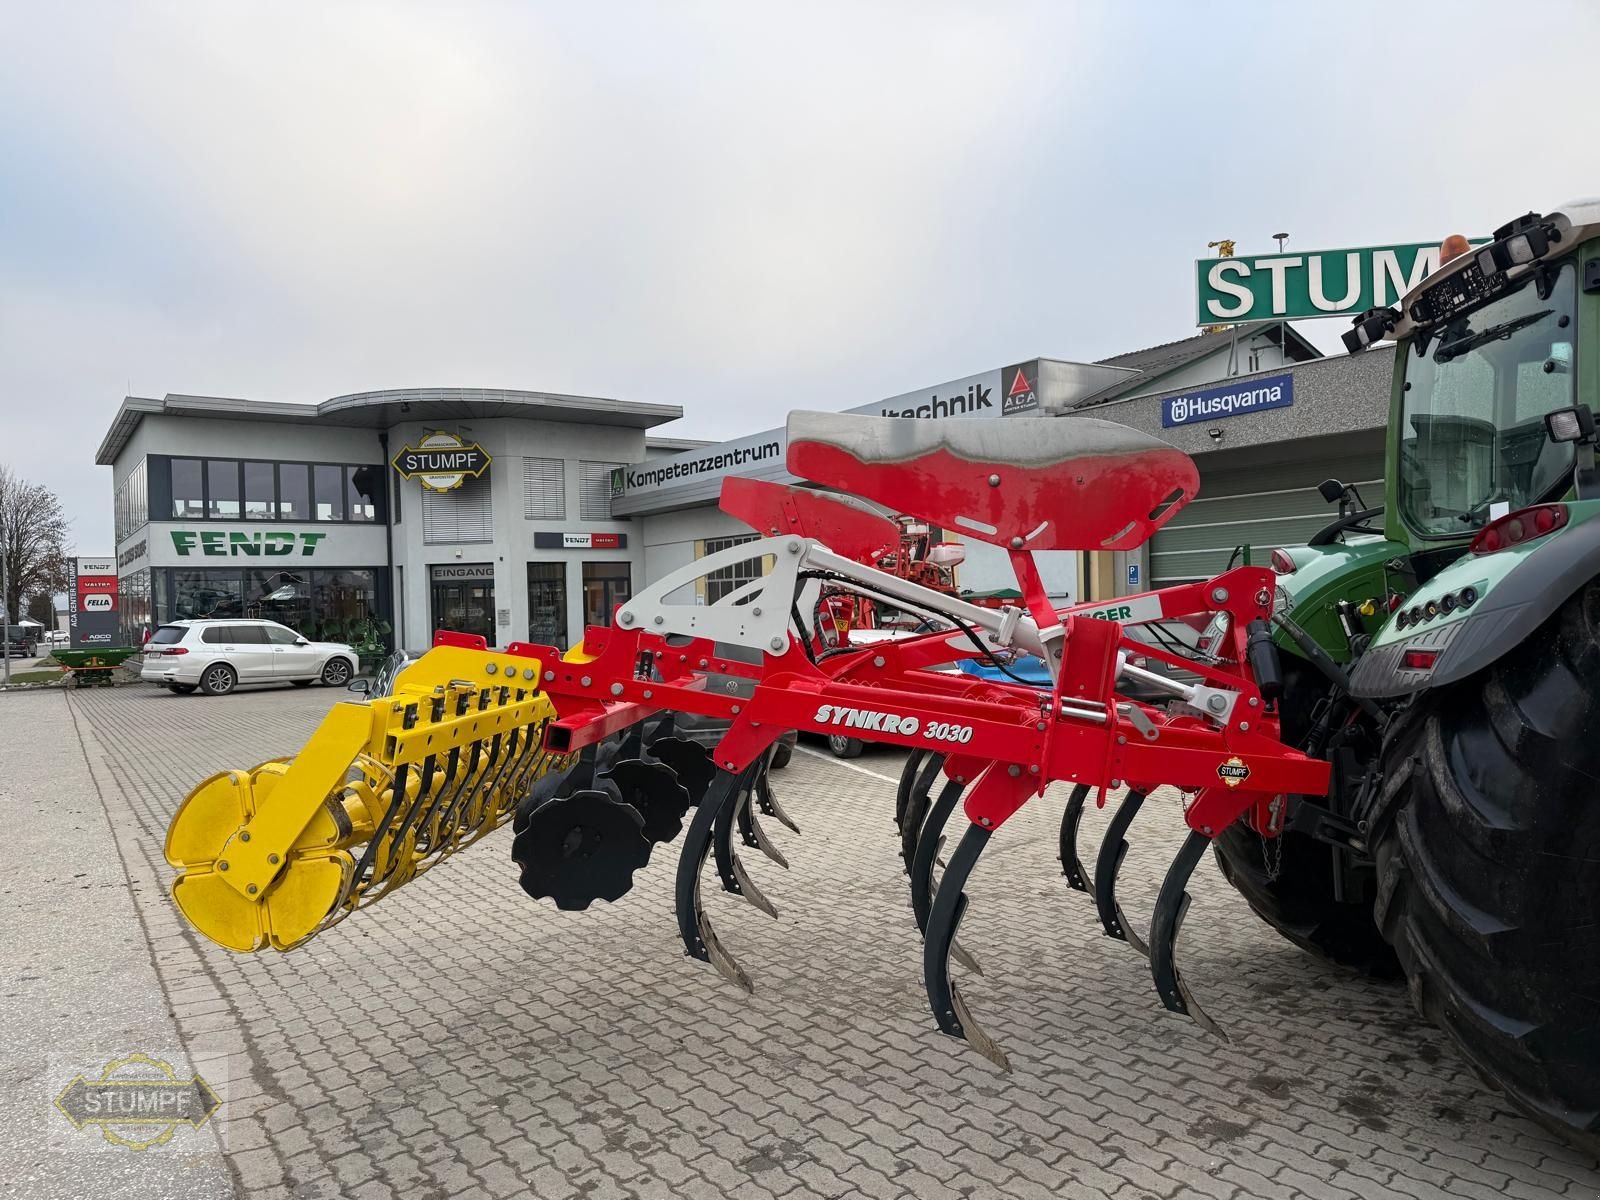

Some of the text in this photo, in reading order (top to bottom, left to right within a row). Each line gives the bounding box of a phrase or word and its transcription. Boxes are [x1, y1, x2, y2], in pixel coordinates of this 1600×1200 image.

[1206, 244, 1481, 318] STUM
[1004, 391, 1036, 408] ACA
[1189, 386, 1281, 417] Husqvarna
[406, 452, 478, 470] STUMPF
[626, 441, 780, 489] Kompetenzzentrum
[170, 531, 327, 556] FENDT
[434, 568, 494, 577] EINGANG
[70, 613, 78, 627] ACA
[814, 704, 974, 744] SYNKRO 3030
[1221, 766, 1247, 776] STUMPF
